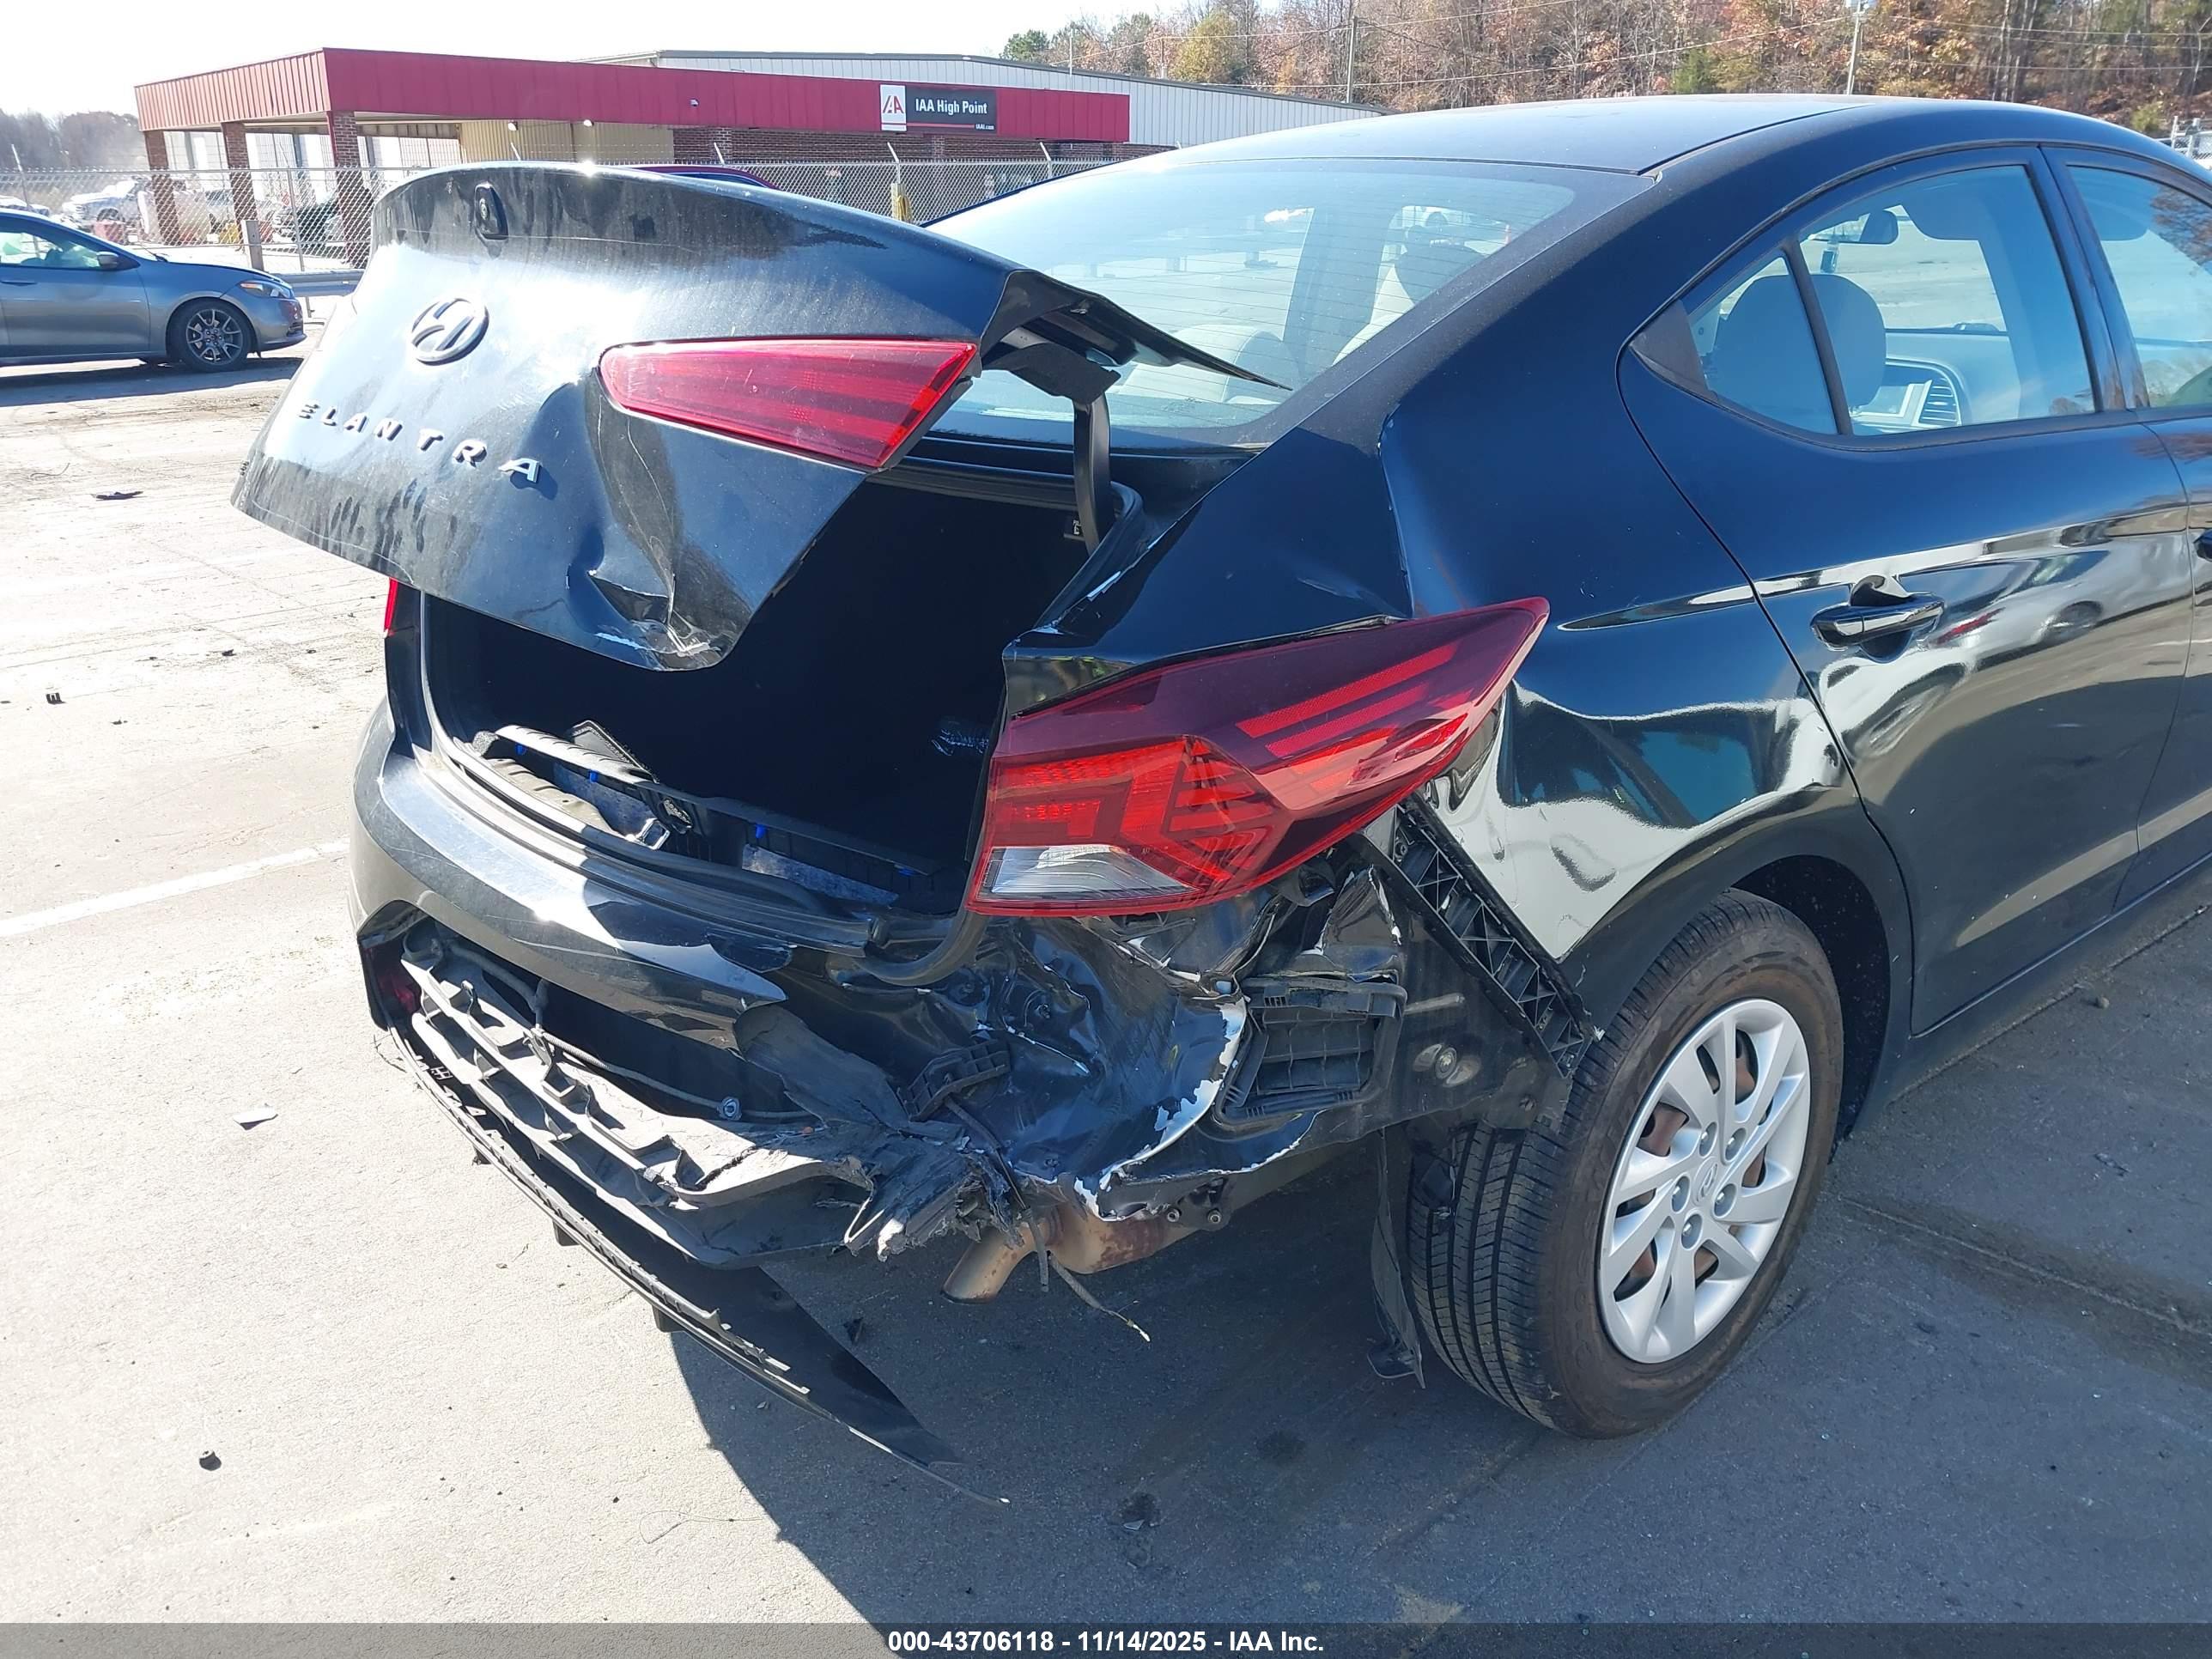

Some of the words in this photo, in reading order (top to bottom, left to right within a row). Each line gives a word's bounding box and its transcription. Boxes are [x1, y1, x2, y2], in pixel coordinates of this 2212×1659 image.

[915, 99, 935, 112] IAA
[937, 99, 960, 116] High
[962, 100, 988, 114] Point
[299, 403, 542, 483] ELANTRA
